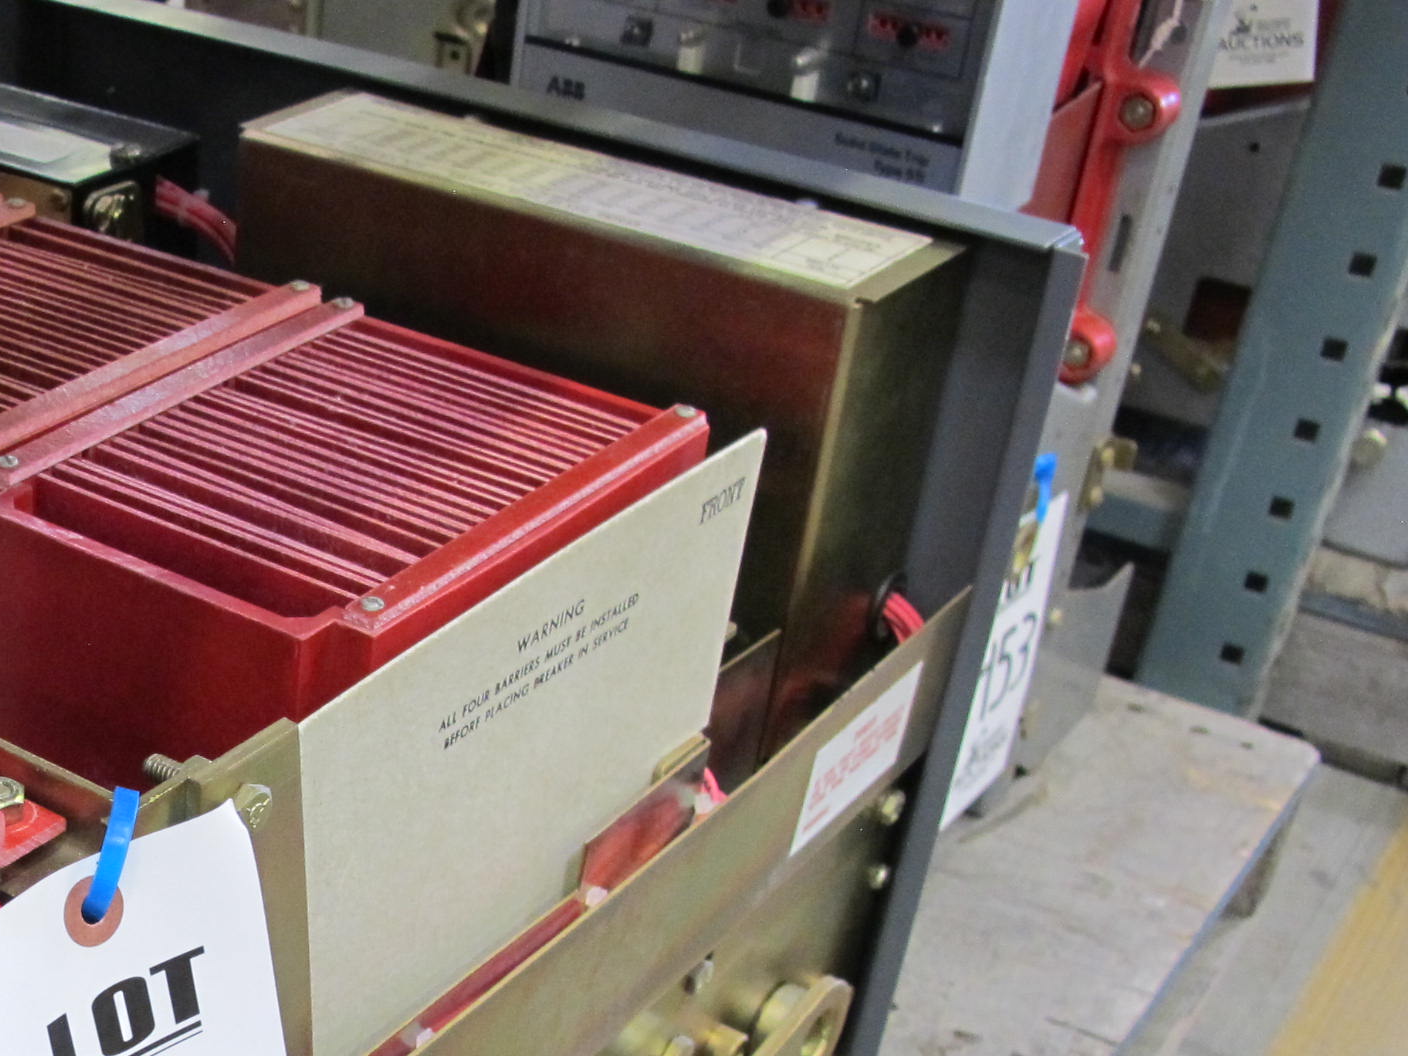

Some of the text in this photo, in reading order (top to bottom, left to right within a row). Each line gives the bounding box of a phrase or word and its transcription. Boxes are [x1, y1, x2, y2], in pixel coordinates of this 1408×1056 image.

[546, 75, 586, 101] ABB
[700, 477, 745, 525] FRONT
[517, 599, 585, 653] WARNING
[439, 592, 640, 732] ALL FOUR BARRIERS MUST BE INSTALLED
[444, 617, 630, 750] BEFORE PLACING BREAKER IN SERVICE
